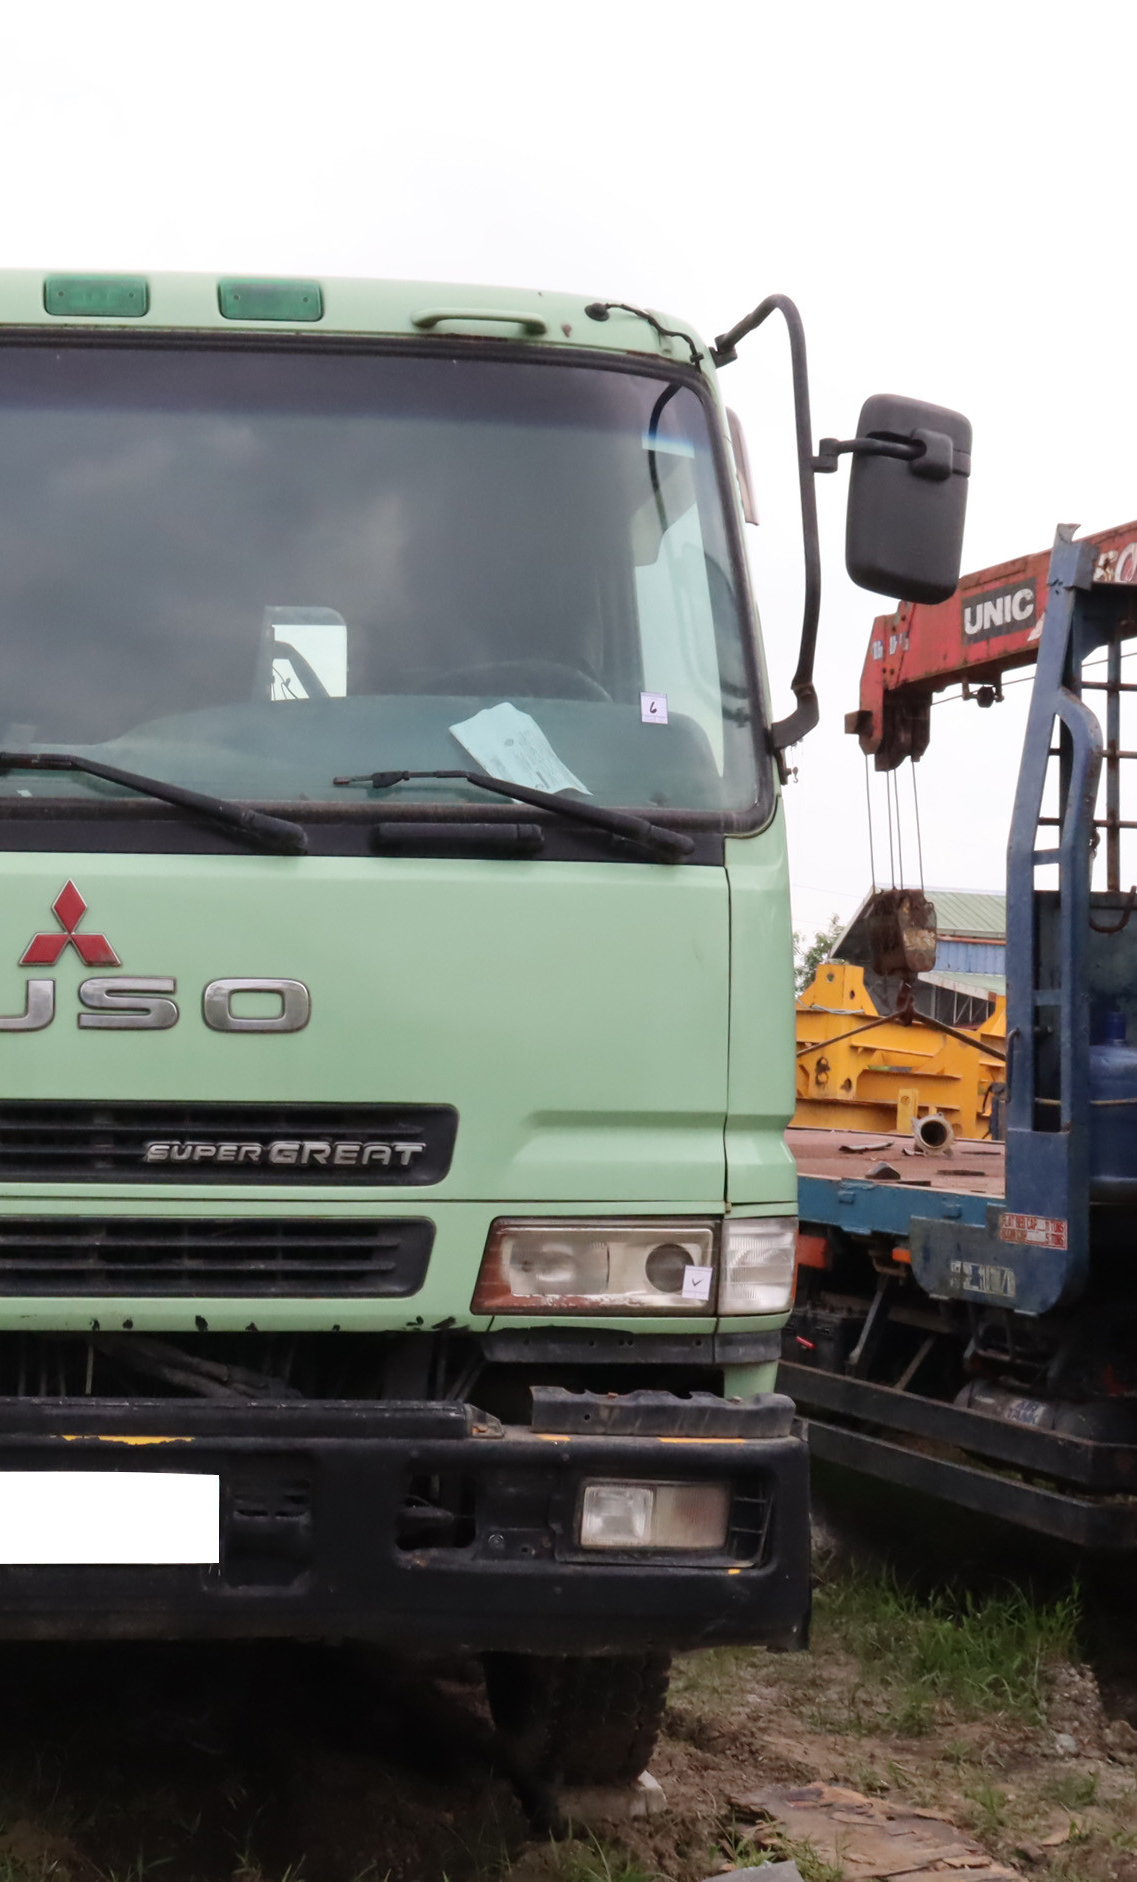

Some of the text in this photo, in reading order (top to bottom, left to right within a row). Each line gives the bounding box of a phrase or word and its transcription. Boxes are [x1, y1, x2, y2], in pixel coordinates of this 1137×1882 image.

[964, 588, 1034, 635] UNIC
[650, 702, 657, 713] 6
[145, 1141, 426, 1166] SUPER GREAT
